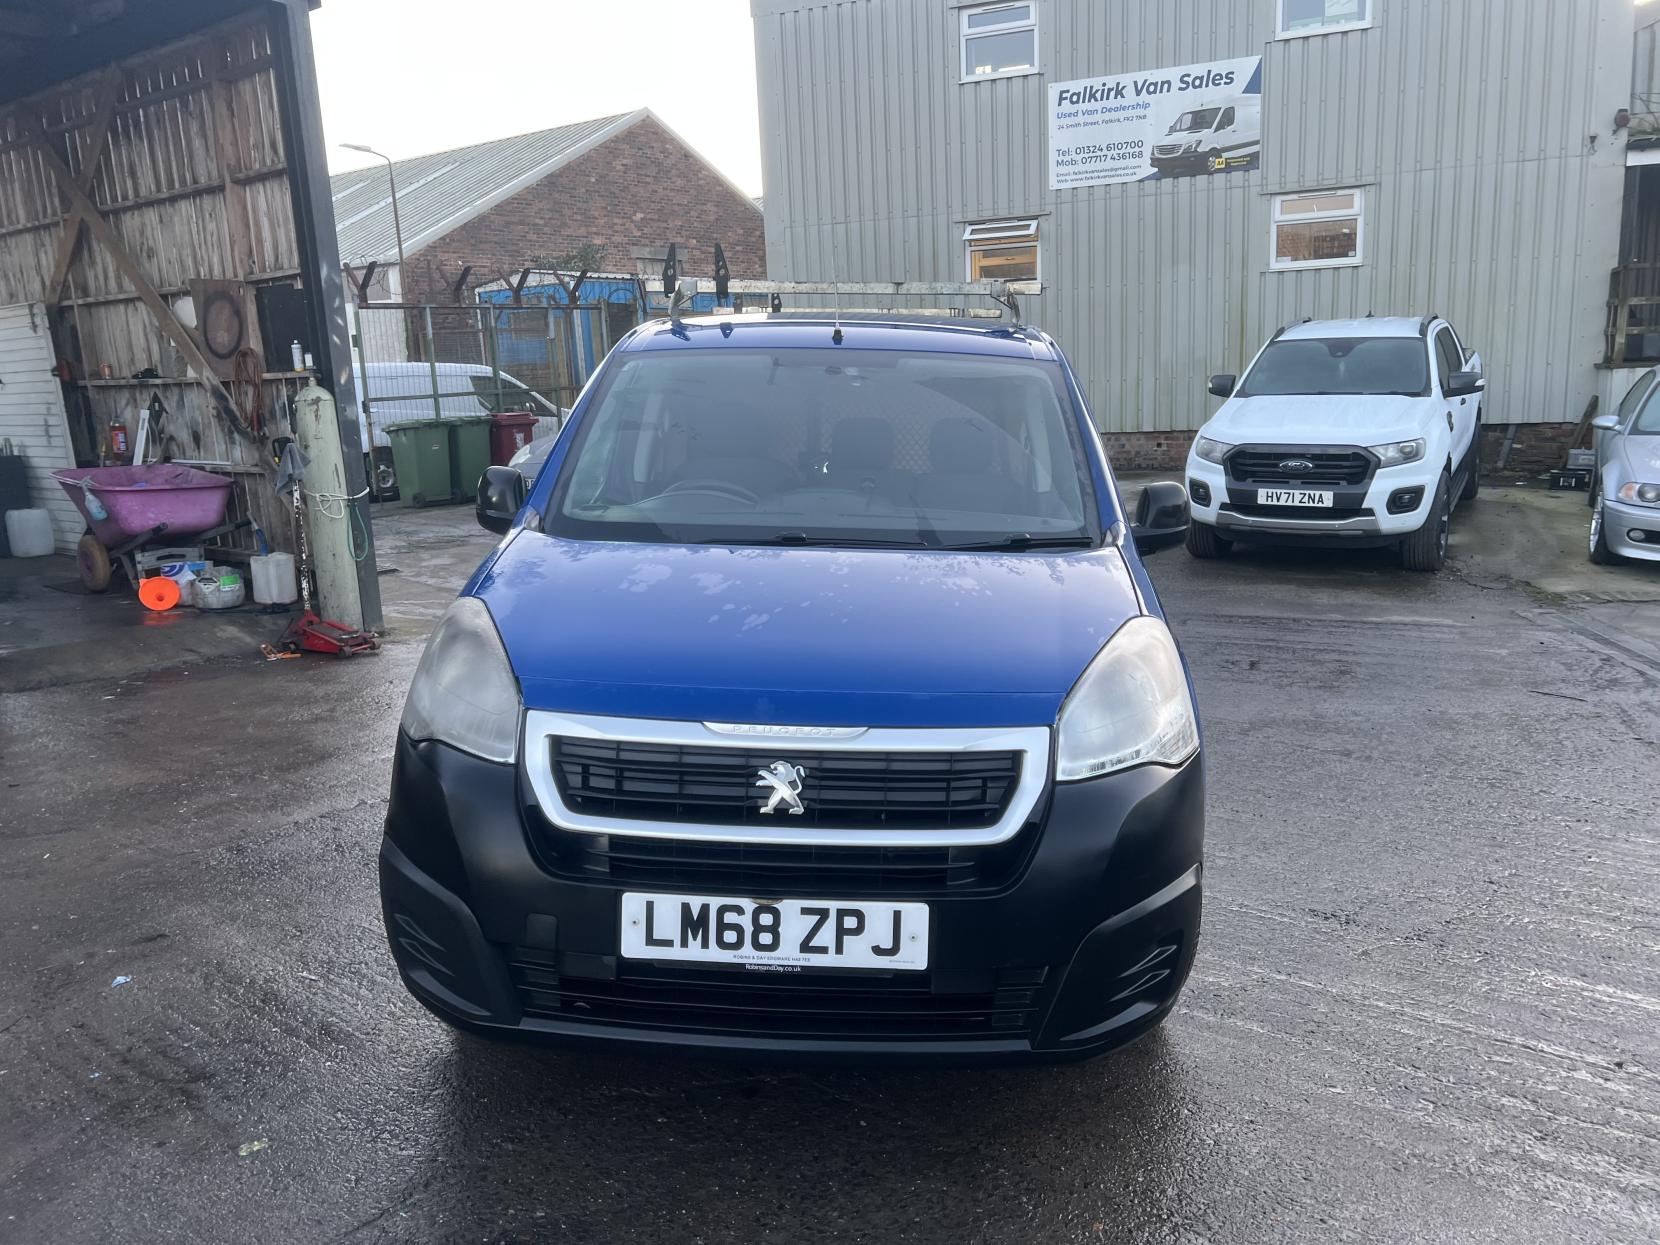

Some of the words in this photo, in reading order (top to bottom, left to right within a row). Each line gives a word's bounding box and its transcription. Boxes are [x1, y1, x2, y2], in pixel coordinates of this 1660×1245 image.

[1057, 82, 1127, 107] Falkirk
[1133, 79, 1172, 97] Van
[1178, 69, 1235, 91] Sales
[1056, 109, 1079, 119] Used
[1081, 108, 1098, 116] Van
[1101, 101, 1151, 114] Dealership
[1056, 147, 1073, 157] Tel:
[1075, 145, 1104, 155] 01324
[1106, 140, 1144, 151] 610700
[1056, 158, 1079, 167] Mob:
[1081, 154, 1108, 164] 07717
[1110, 150, 1144, 161] 436168
[1265, 491, 1294, 503] HV71
[1299, 493, 1324, 504] ZNA
[733, 725, 836, 737] PEUGEOT
[644, 900, 782, 952] LM68
[799, 907, 902, 957] ZPJ
[745, 963, 801, 973] RobinsandDay.co.uk
